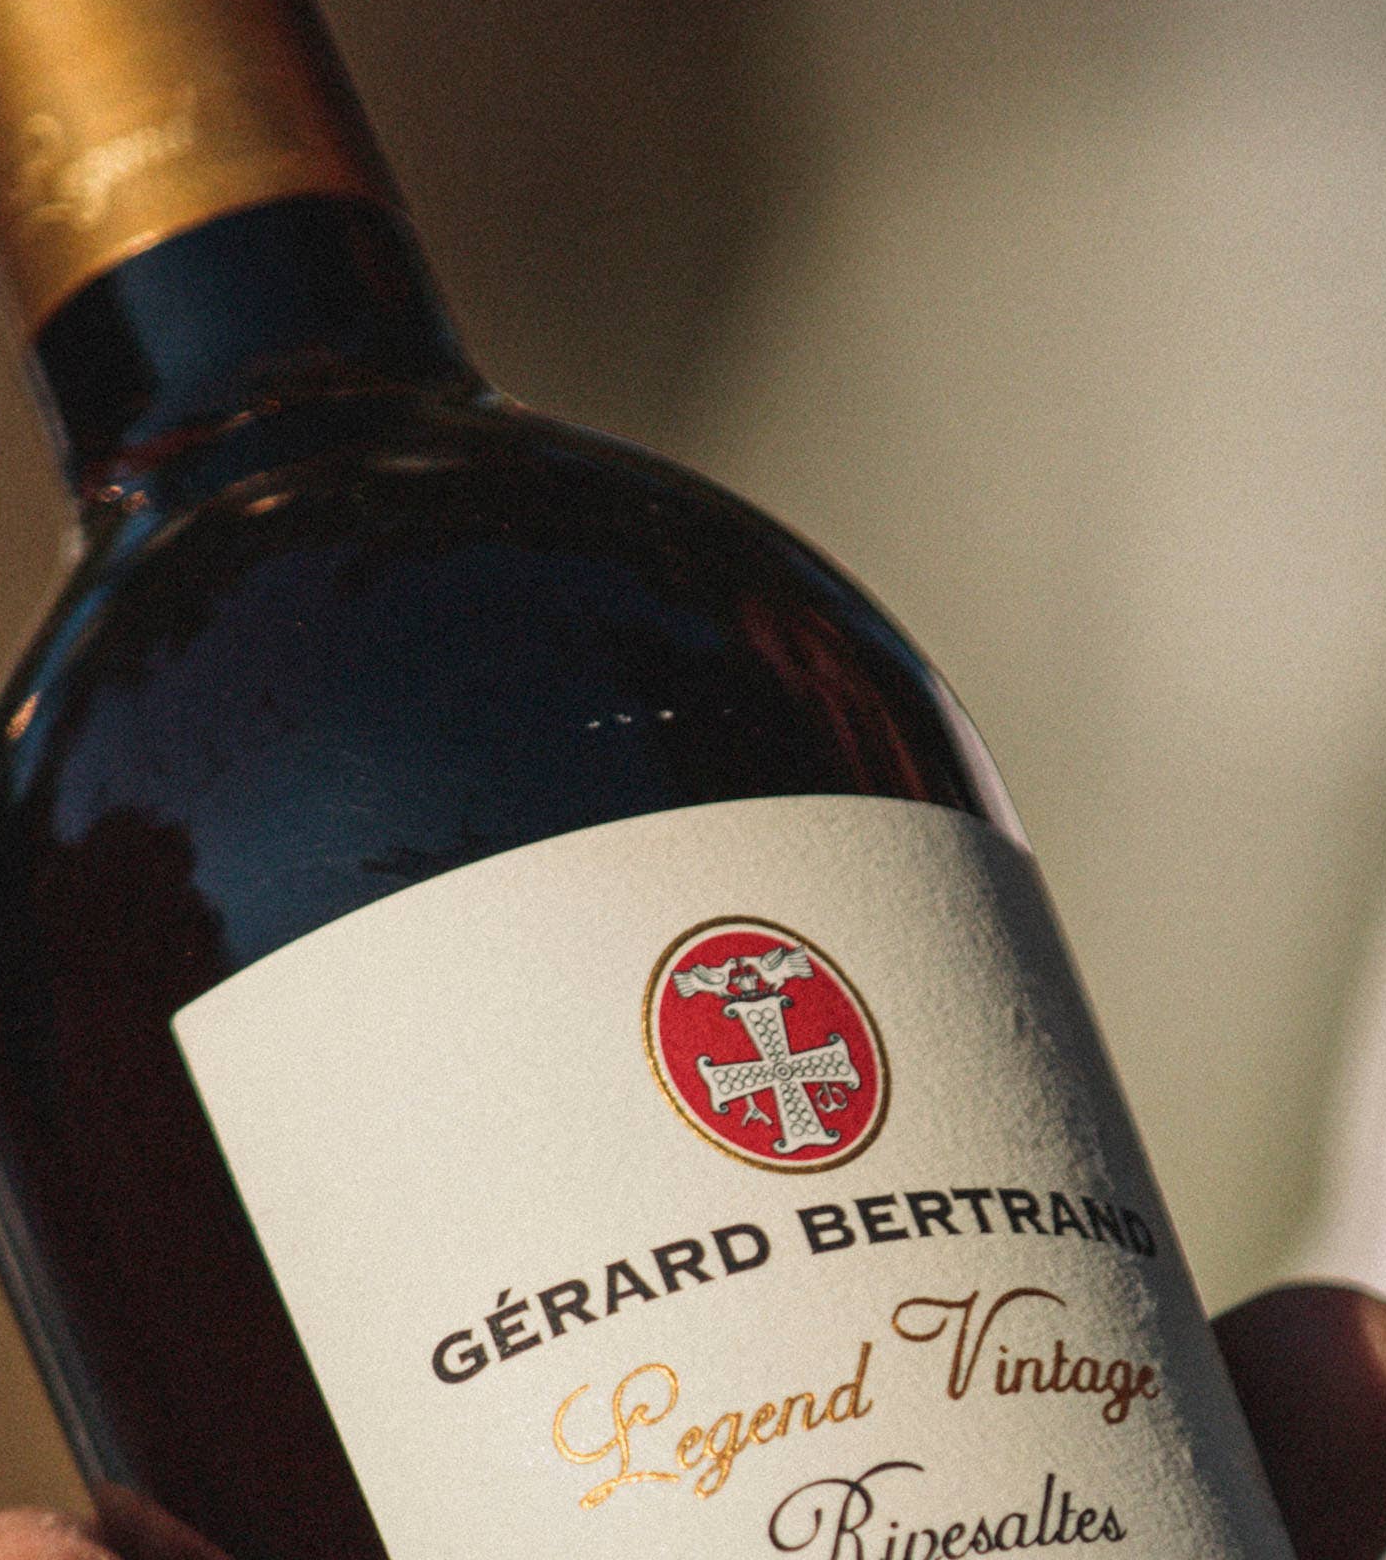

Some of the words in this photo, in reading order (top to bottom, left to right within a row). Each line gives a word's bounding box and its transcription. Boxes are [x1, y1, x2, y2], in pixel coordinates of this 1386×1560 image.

[431, 1222, 772, 1385] GÉRARD
[796, 1186, 1158, 1258] BERTRAND
[552, 1341, 874, 1510] Legend
[891, 1286, 1161, 1426] Vintage
